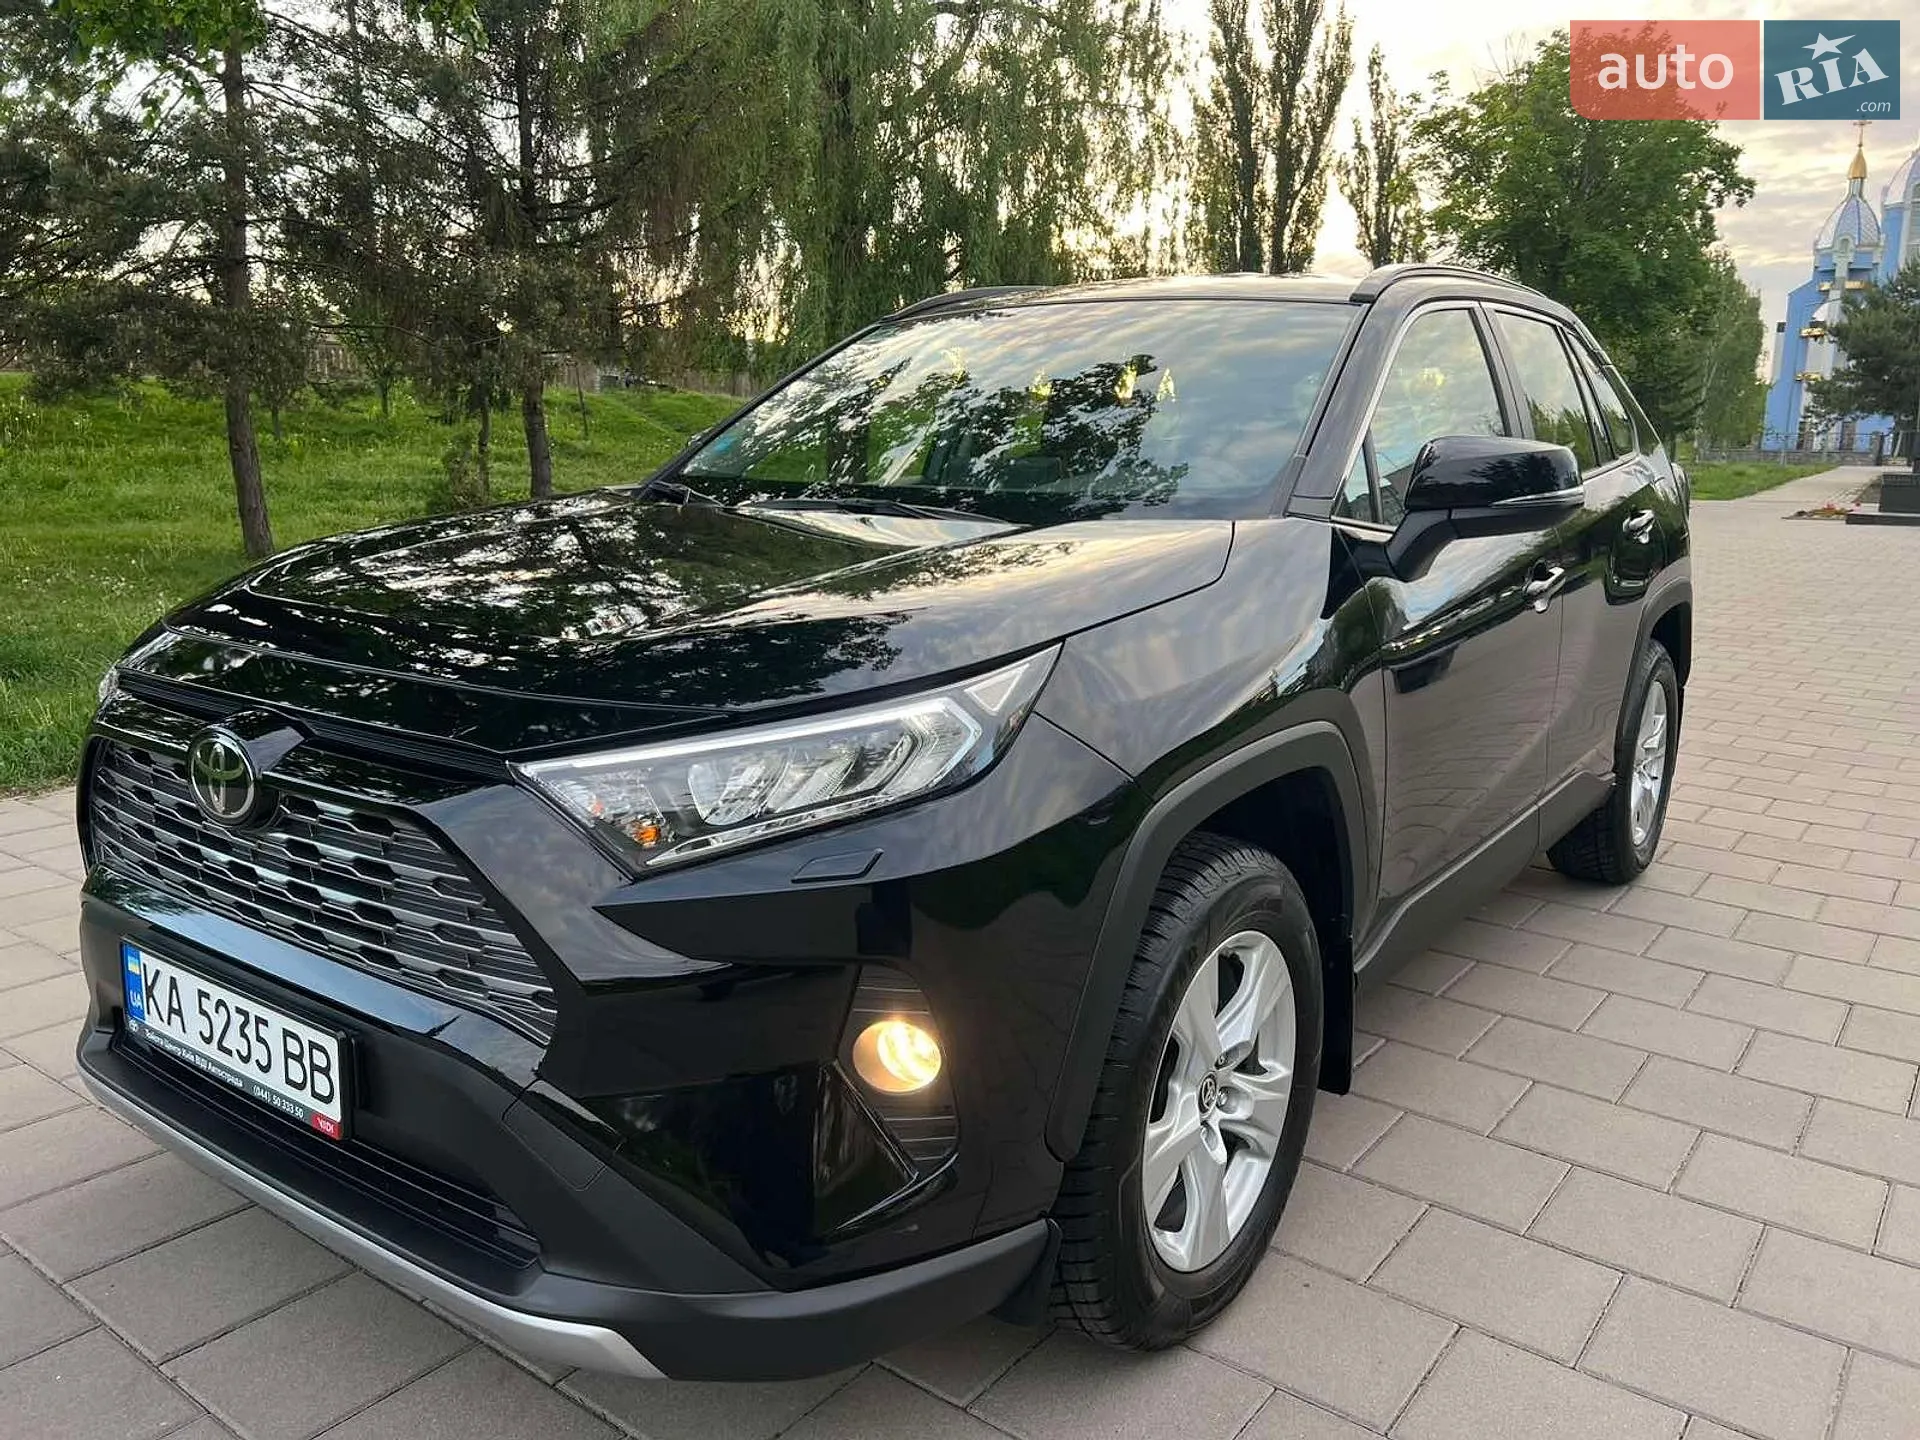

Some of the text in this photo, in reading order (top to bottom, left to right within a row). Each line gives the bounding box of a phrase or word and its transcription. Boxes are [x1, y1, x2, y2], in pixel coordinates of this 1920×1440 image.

[129, 992, 143, 1010] UA
[143, 963, 187, 1034] KA
[197, 988, 273, 1074] 5235
[282, 1027, 335, 1105] BB
